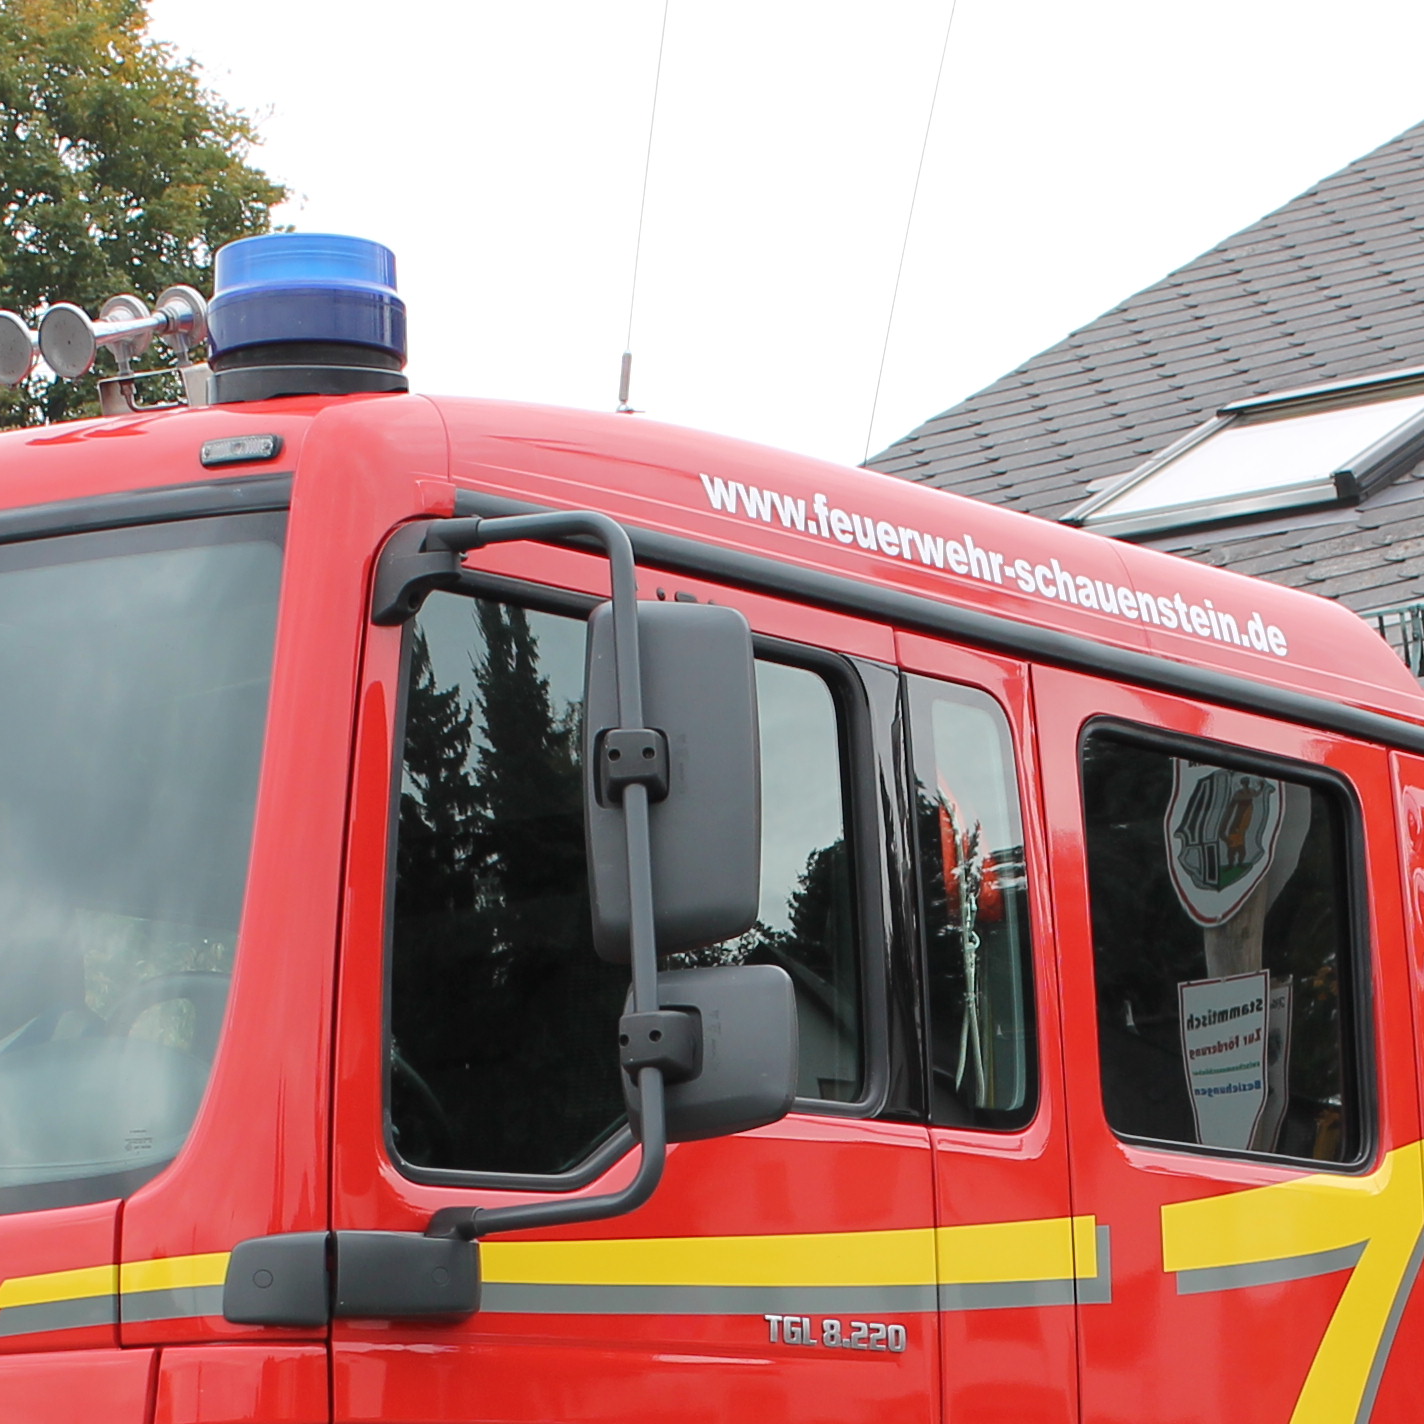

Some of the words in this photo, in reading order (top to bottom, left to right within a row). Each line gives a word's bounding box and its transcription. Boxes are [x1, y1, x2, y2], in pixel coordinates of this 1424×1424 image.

[699, 472, 1289, 658] www.feuerwehr-schauenstein.de
[764, 1314, 816, 1347] TGL
[821, 1318, 908, 1353] 8.220
